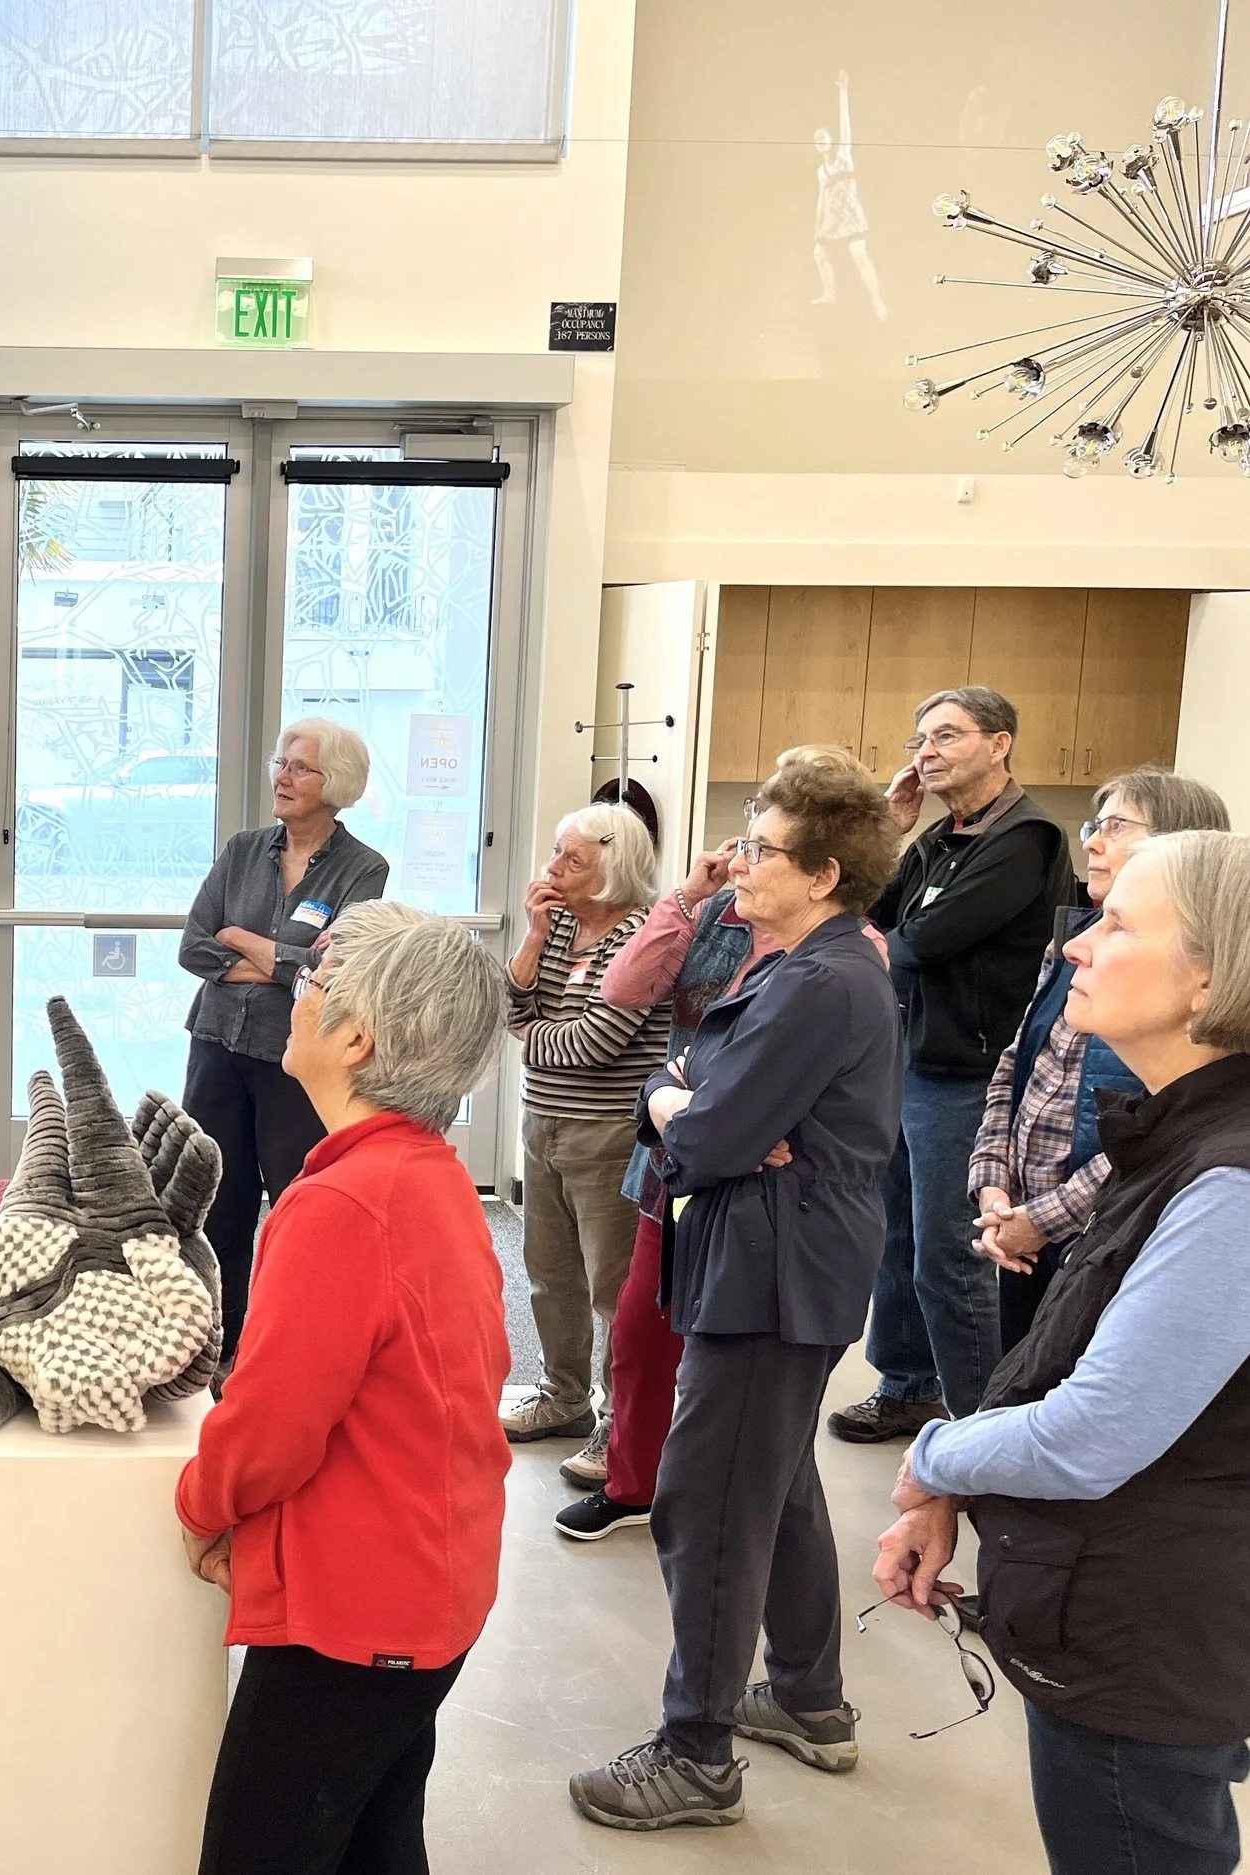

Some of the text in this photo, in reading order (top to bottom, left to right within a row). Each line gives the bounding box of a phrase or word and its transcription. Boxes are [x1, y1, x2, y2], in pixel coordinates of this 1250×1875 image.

[235, 290, 297, 338] EXIT
[561, 319, 606, 329] OCCUPANCY
[576, 331, 611, 340] PERSONS
